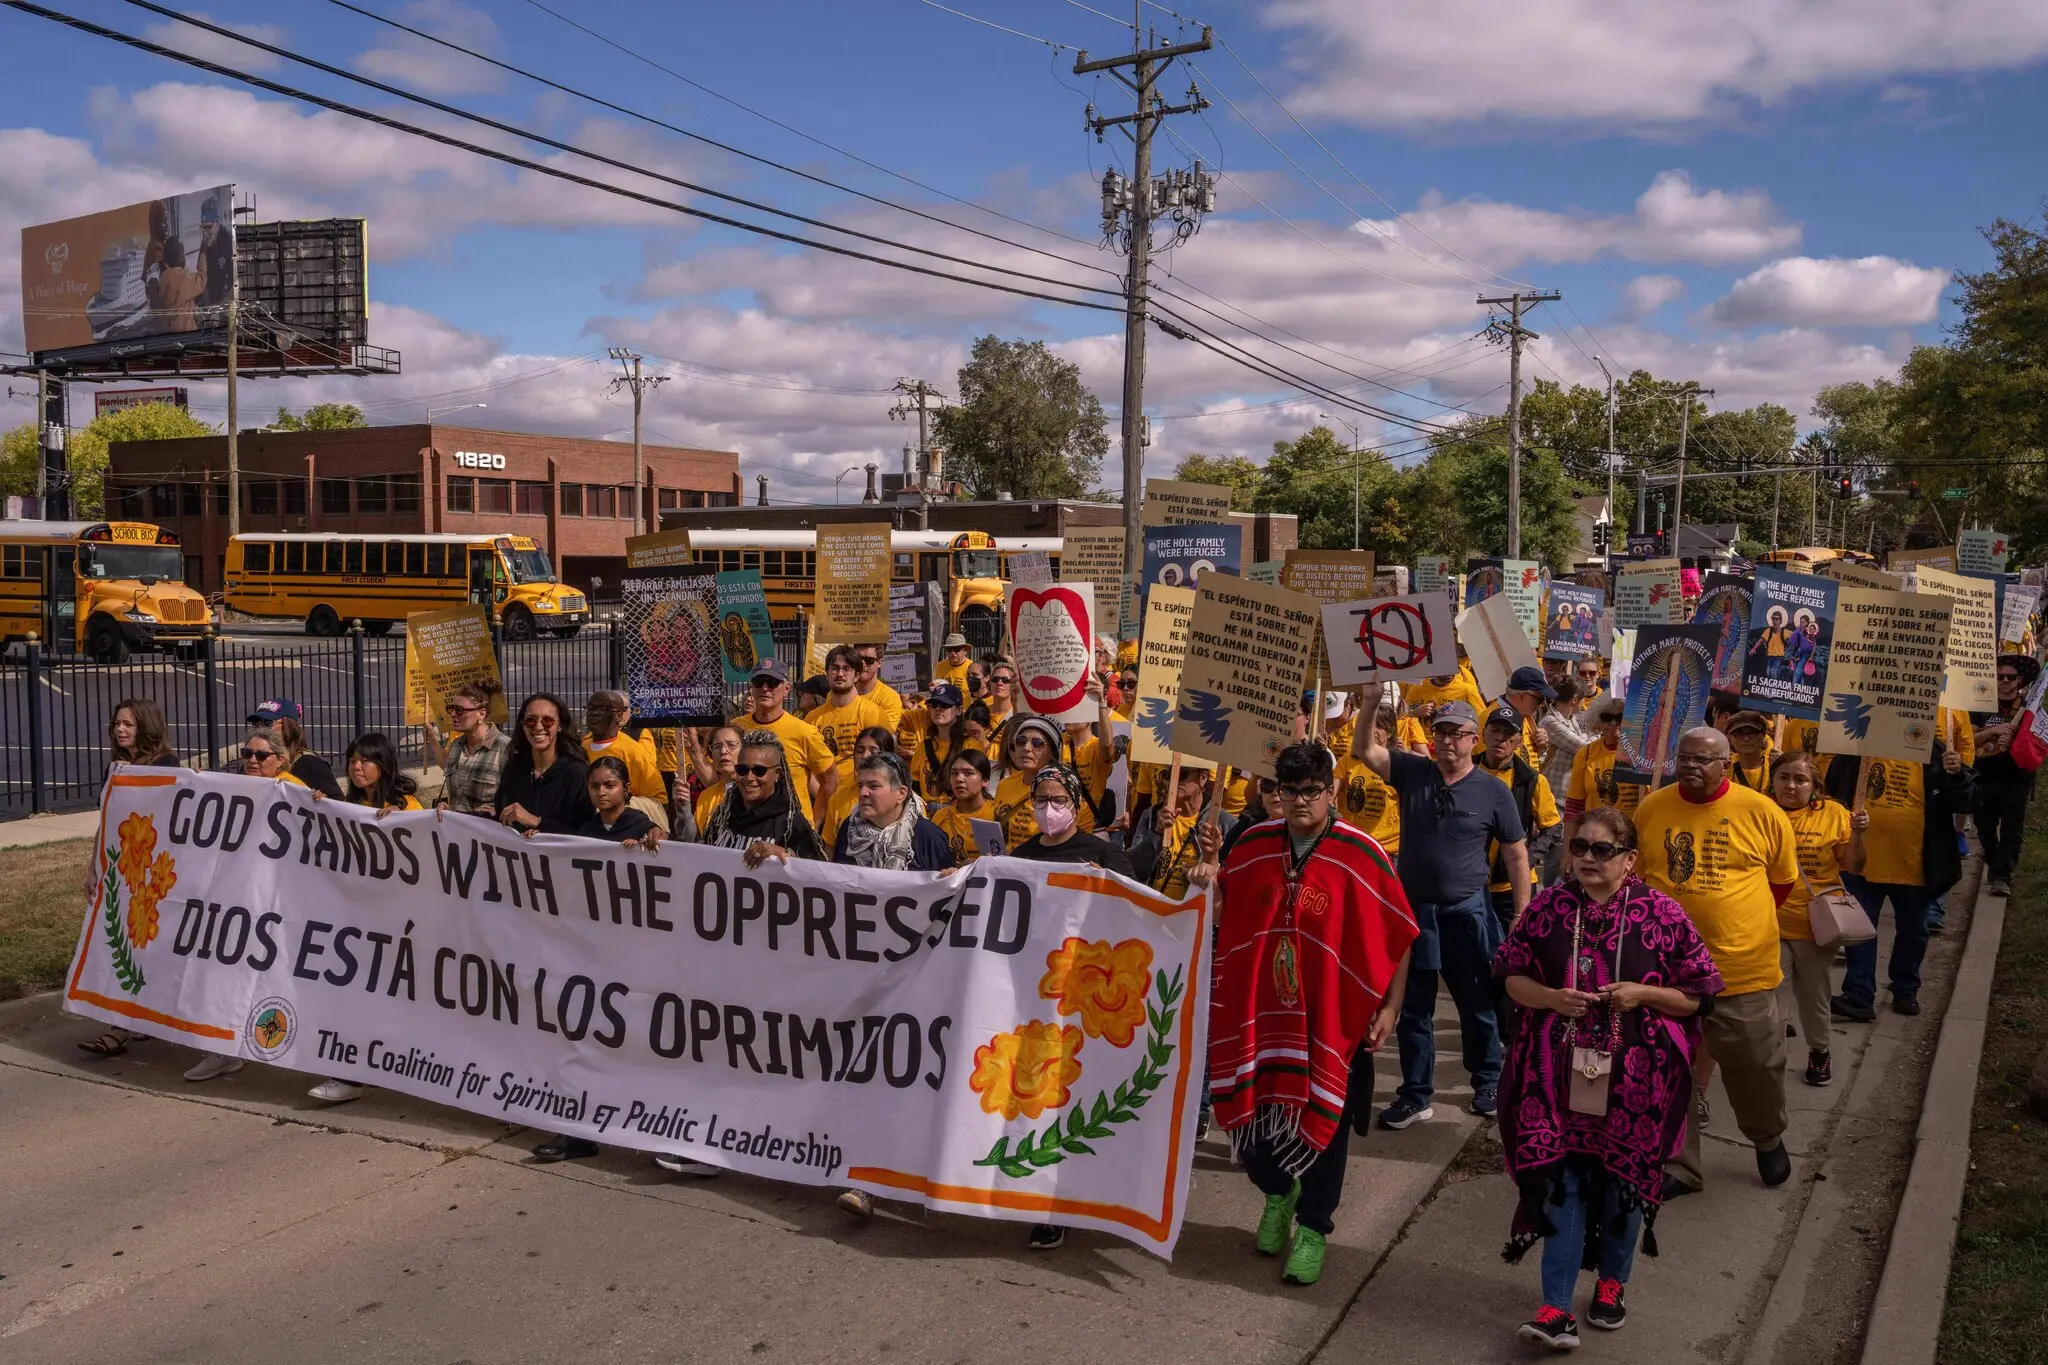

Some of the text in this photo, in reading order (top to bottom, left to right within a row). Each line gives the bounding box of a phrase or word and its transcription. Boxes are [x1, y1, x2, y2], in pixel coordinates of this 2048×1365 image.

[99, 396, 128, 406] Worried
[453, 451, 506, 470] 1820
[1160, 493, 1189, 504] ESPÍRITU
[1191, 498, 1204, 506] DEL
[1207, 499, 1228, 508] SEÑOR
[114, 527, 154, 540] SCHOOL BUS
[1157, 538, 1225, 548] THE HOLY FAMILY
[1158, 547, 1226, 558] WERE REFUGEES
[625, 579, 715, 593] SEPARAR FAMILIAS ES
[717, 583, 728, 593] OS
[748, 581, 761, 591] CON
[1766, 580, 1826, 598] THE HOLY FAMILY
[1930, 581, 1955, 593] ESPÍRITU
[1956, 587, 1968, 596] DEL
[1970, 588, 1993, 599] SEÑOR
[641, 593, 653, 603] UN
[717, 594, 763, 605] OS OPRIMIDOS
[1767, 590, 1825, 609] WERE REFUGEES
[1218, 592, 1262, 611] ESPÍRITU
[1264, 603, 1282, 617] DEL
[1284, 607, 1314, 626] SEÑOR
[1857, 604, 1896, 616] ESPÍRITU
[1899, 608, 1915, 618] DEL
[1919, 609, 1949, 621] SEÑOR
[1022, 619, 1072, 628] PROVERBS
[1230, 610, 1253, 624] ESTÁ
[1256, 617, 1286, 633] SOBRE
[1868, 617, 1889, 628] ESTÁ
[1891, 619, 1922, 630] SOBRE
[1224, 623, 1308, 654] ME HA ENVIADO A
[1863, 630, 1945, 647] ME HA ENVIADO A
[1192, 631, 1305, 669] PROCLAMAR LIBERTAD A
[1631, 637, 1715, 671] MOTHER MARY, PROTECT US
[1834, 641, 1943, 660] PROCLAMAR LIBERTAD A
[1191, 646, 1302, 684] LOS CAUTIVOS, Y VISTA
[1834, 654, 1941, 672] LOS CAUTIVOS, Y VISTA
[1748, 675, 1820, 696] LA SAGRADA FAMILIA
[1871, 670, 1939, 686] A LOS CIEGOS,
[634, 686, 721, 699] SEPARATING FAMILIES
[1751, 685, 1815, 705] ERAN REFUGIADOS
[1849, 681, 1937, 698] Y A LIBERAR A LOS
[652, 698, 707, 710] IS A SCANDAL
[1620, 732, 1635, 759] MADRE
[168, 788, 1032, 963] GOD STANDS WITH THE OPPRESSED
[173, 898, 952, 1092] DIOS ESTÁ CON LOS OPRIMIDOS
[317, 1029, 358, 1065] The
[367, 1040, 454, 1088] Coalition
[456, 1062, 491, 1099] for
[493, 1072, 587, 1121] Spiritual
[622, 1100, 698, 1144] Public
[704, 1113, 843, 1177] Leadership
